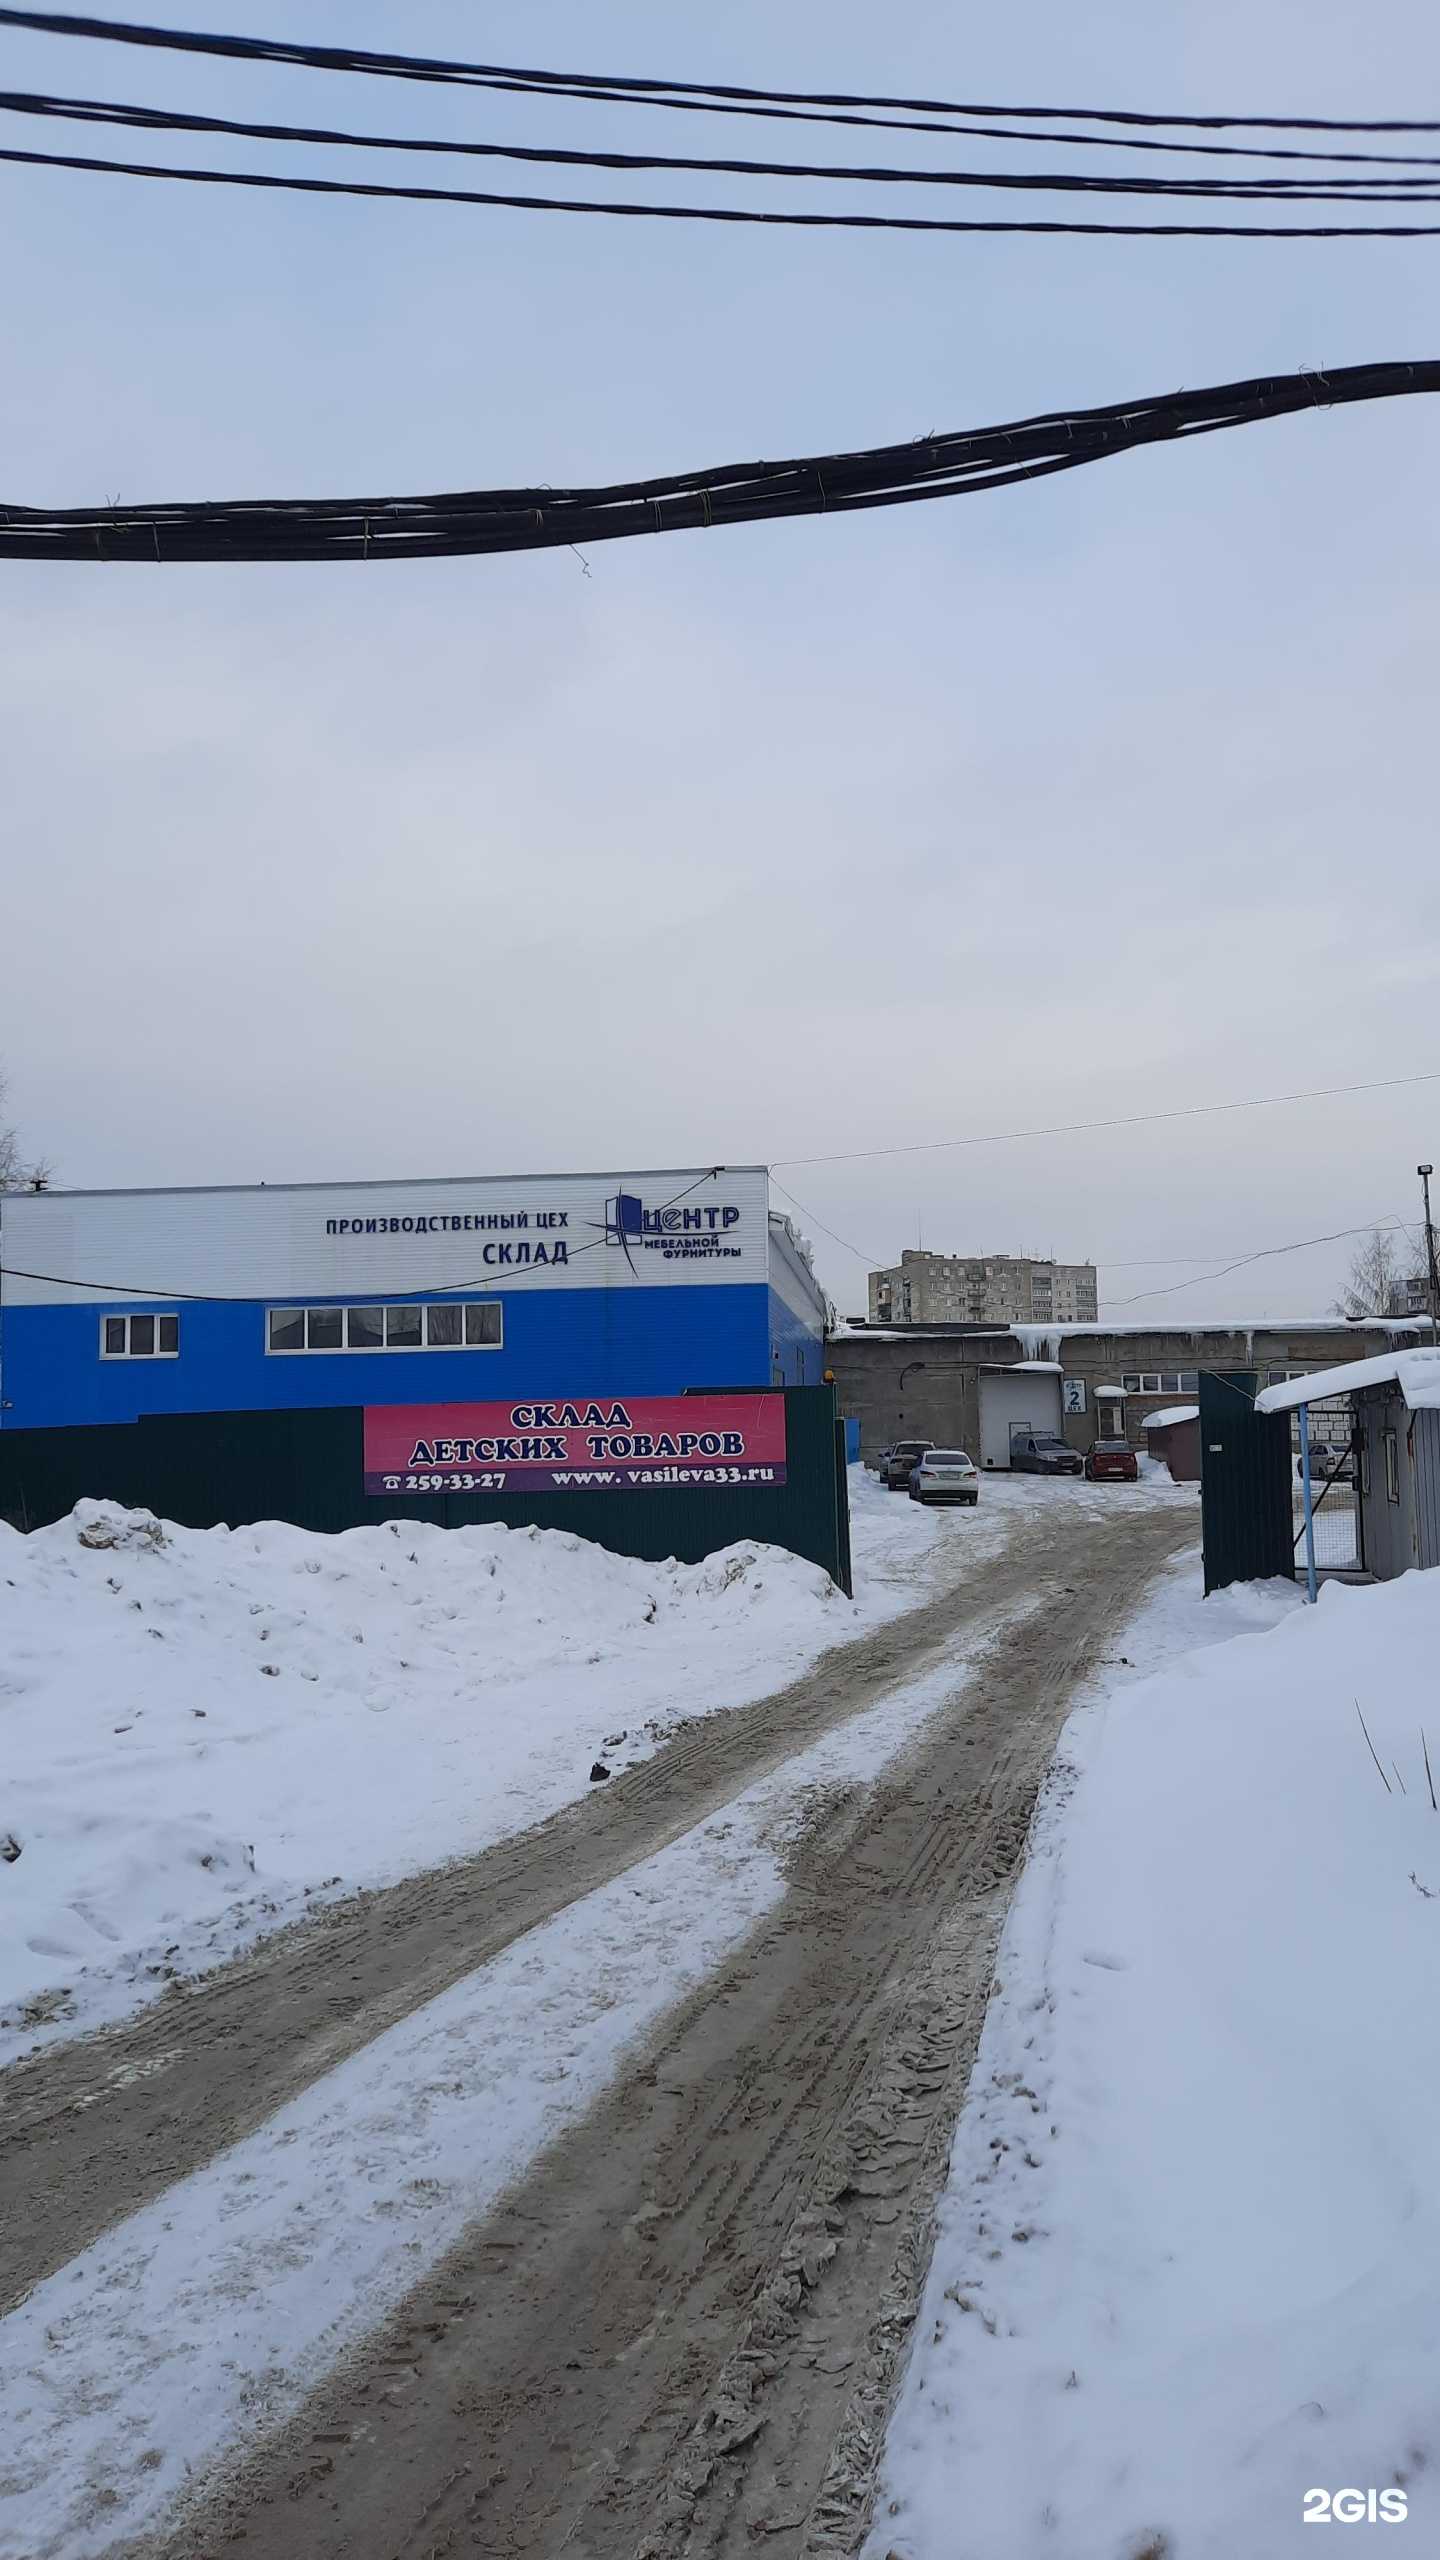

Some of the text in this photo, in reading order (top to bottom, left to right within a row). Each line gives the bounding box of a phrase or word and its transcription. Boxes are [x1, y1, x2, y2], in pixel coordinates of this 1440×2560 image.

[326, 1211, 569, 1234] ПРОИЗВОДСТВЕННЫЙ ЦЕХ
[644, 1234, 720, 1249] МЕБЕЛЬНОЙ
[483, 1241, 569, 1265] СКЛАД
[663, 1247, 742, 1259] ФУРНИТУРЫ
[1070, 1391, 1079, 1405] 2
[510, 1402, 632, 1430] СКЛАД
[408, 1431, 744, 1467] ДЕТСКИХ ТОВАРОВ
[405, 1473, 506, 1491] 259-33-27
[551, 1466, 775, 1485] www. vasileva33.ru
